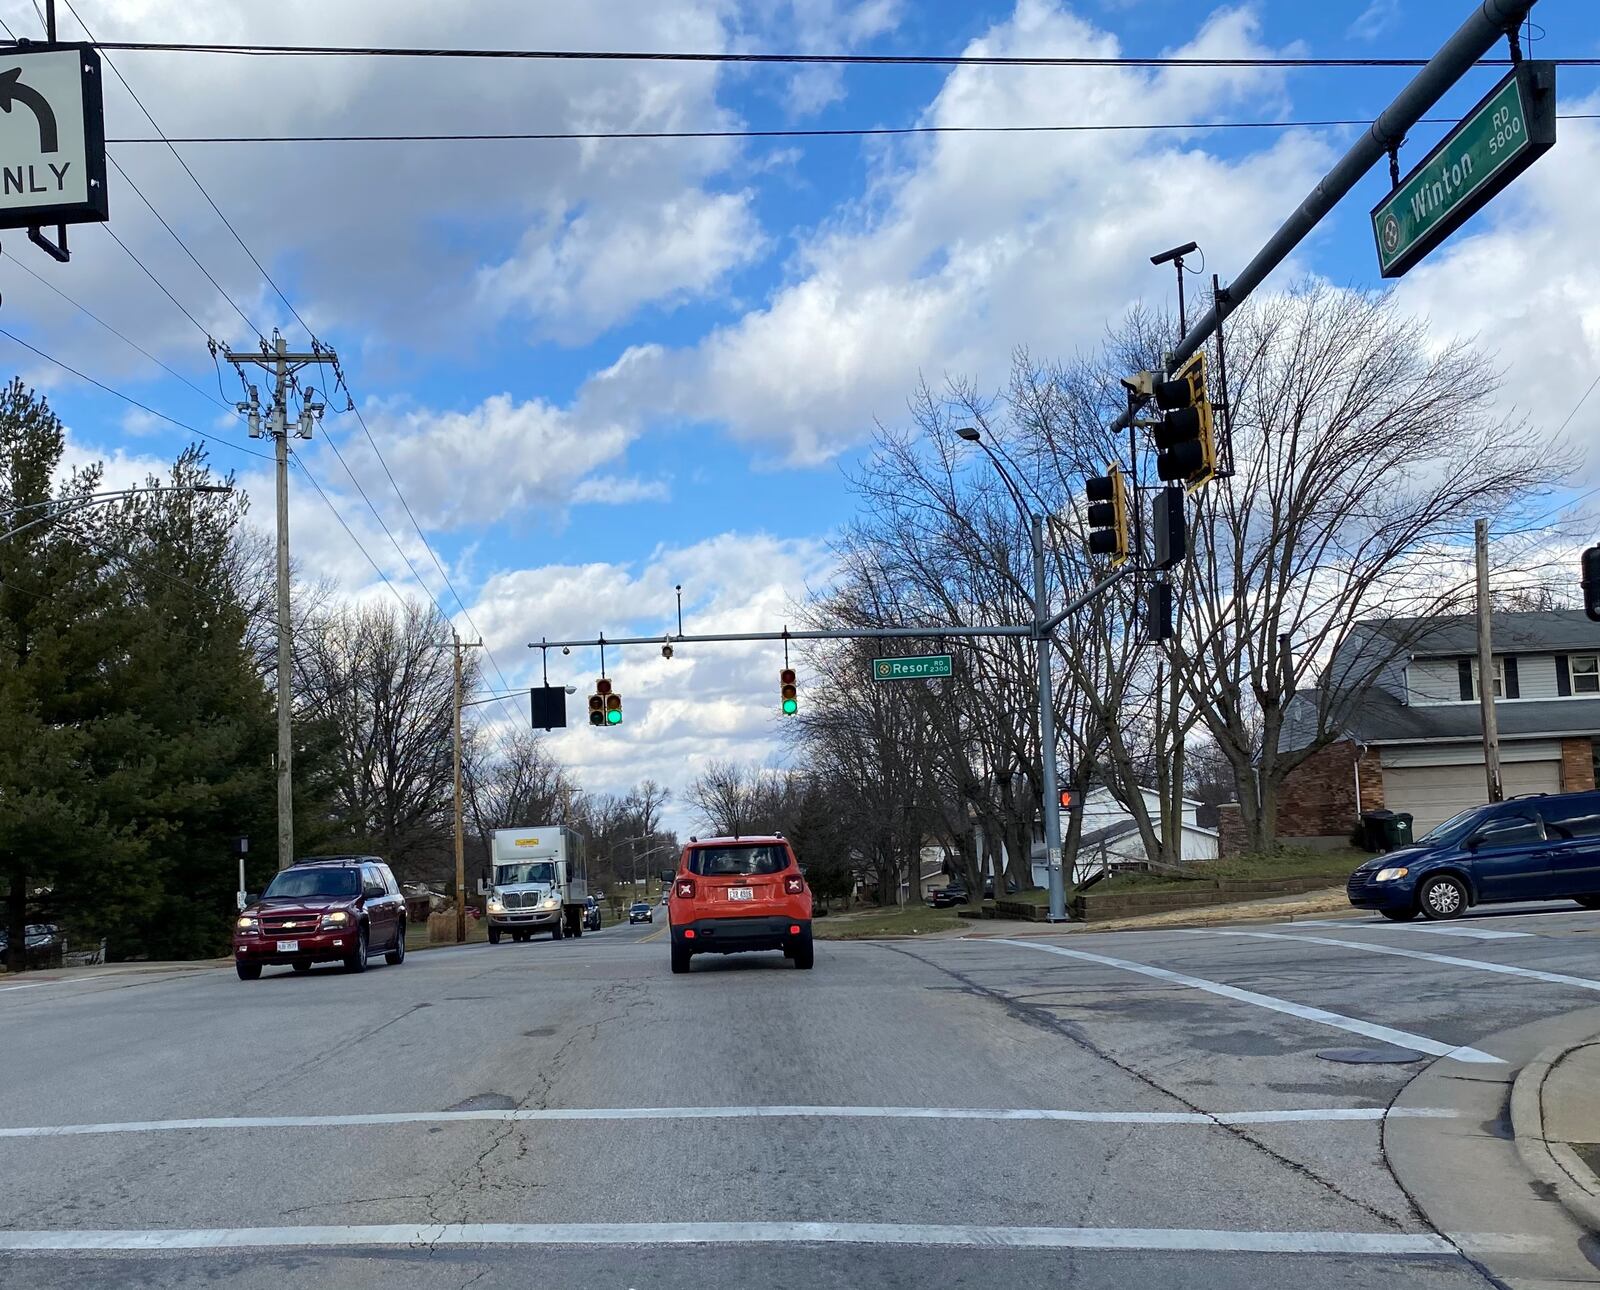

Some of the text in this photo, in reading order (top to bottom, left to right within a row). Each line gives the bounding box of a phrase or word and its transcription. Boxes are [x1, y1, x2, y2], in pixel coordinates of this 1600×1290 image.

[1492, 106, 1510, 131] RD
[1489, 117, 1521, 155] 5800
[3, 162, 71, 195] NLY
[1411, 152, 1473, 223] Winton
[893, 663, 929, 674] Resor
